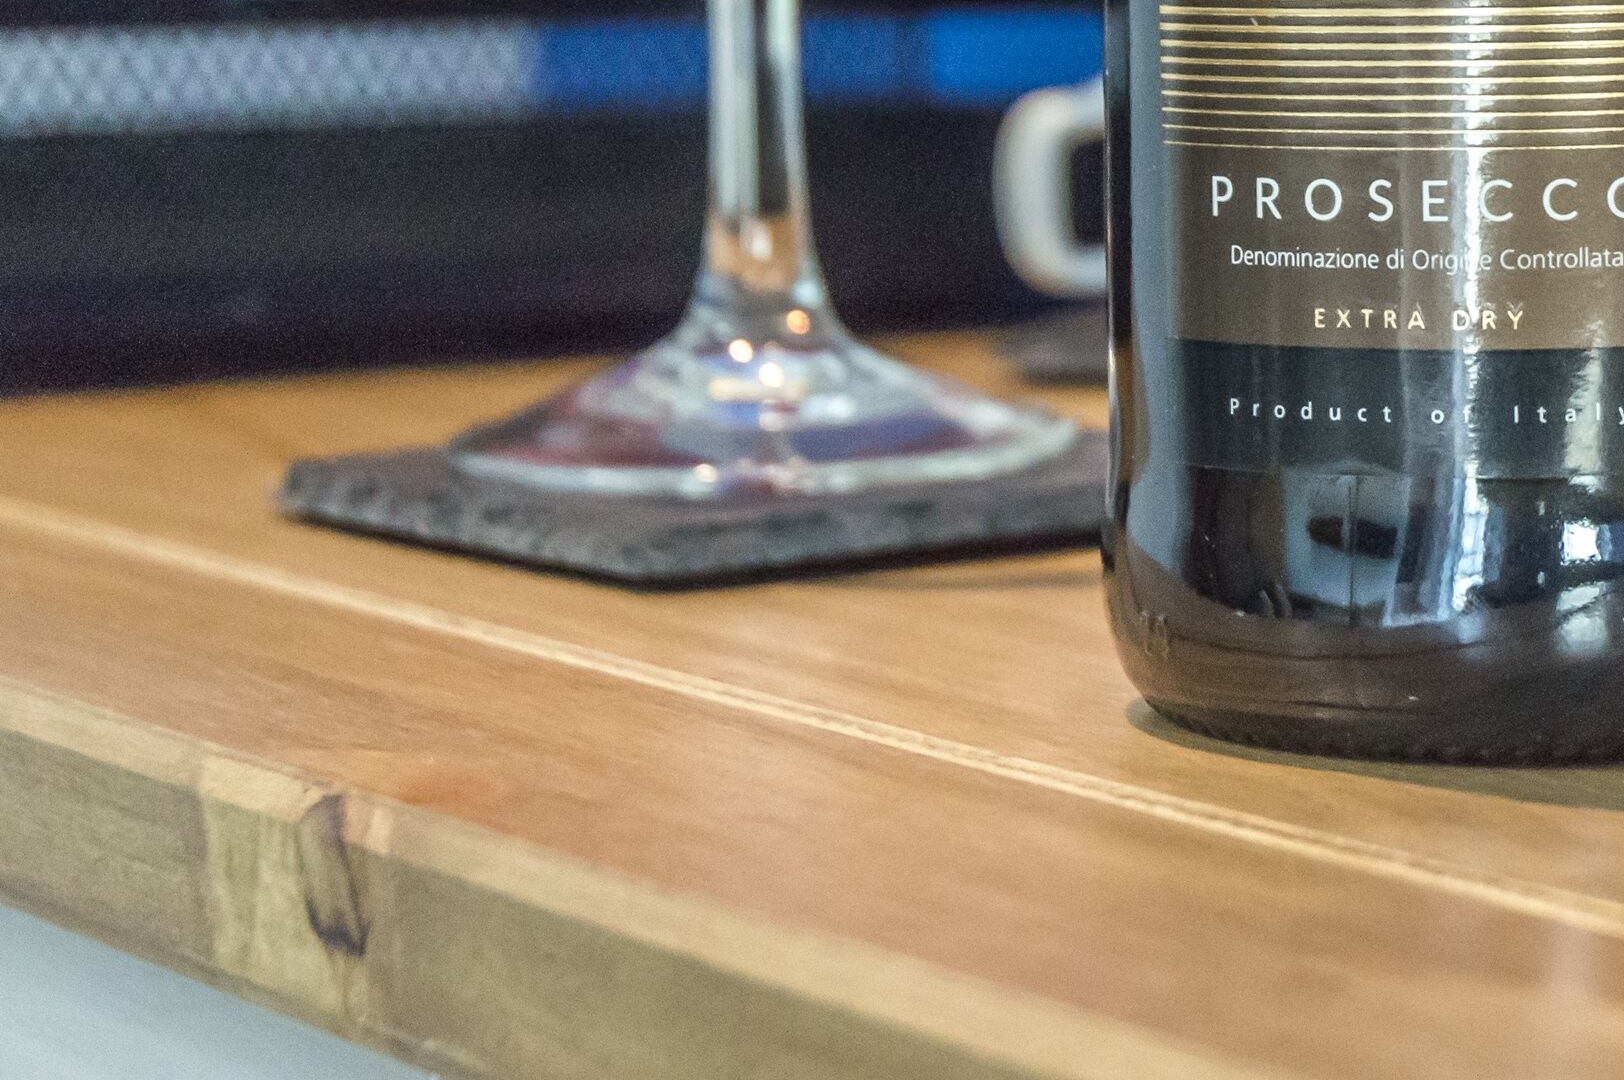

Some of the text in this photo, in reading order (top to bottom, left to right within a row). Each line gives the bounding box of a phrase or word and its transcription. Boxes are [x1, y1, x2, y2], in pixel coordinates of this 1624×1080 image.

[1230, 245, 1380, 270] Denominazione
[1385, 248, 1405, 270] di
[1499, 246, 1624, 270] Controllata
[1313, 307, 1524, 331] EXTRA DRY
[1229, 397, 1393, 423] Product
[1430, 402, 1475, 425] of
